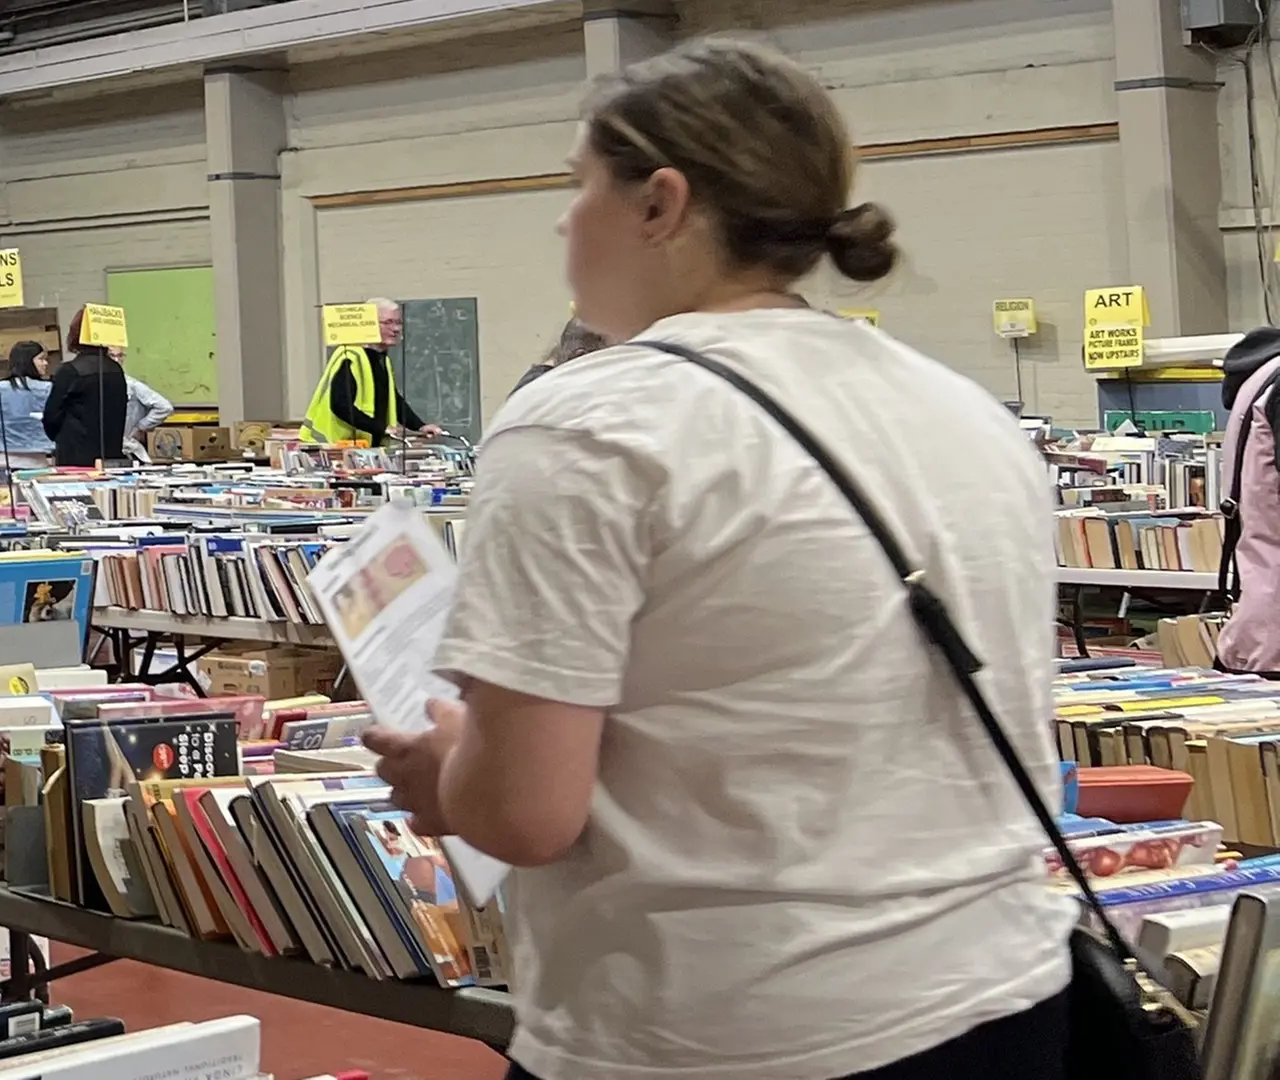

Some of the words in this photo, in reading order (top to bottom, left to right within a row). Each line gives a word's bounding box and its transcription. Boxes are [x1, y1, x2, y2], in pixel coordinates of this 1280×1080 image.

[1094, 292, 1133, 308] ART
[995, 301, 1030, 312] RELIGION
[1090, 330, 1106, 339] ART
[1108, 328, 1137, 338] WORKS
[1089, 339, 1113, 348] PICTURE
[1115, 338, 1139, 347] FRAMES
[1088, 351, 1104, 360] NOW
[1105, 349, 1140, 360] UPSTAIRS
[190, 733, 200, 747] to
[178, 733, 190, 775] Sleep
[191, 749, 200, 760] a
